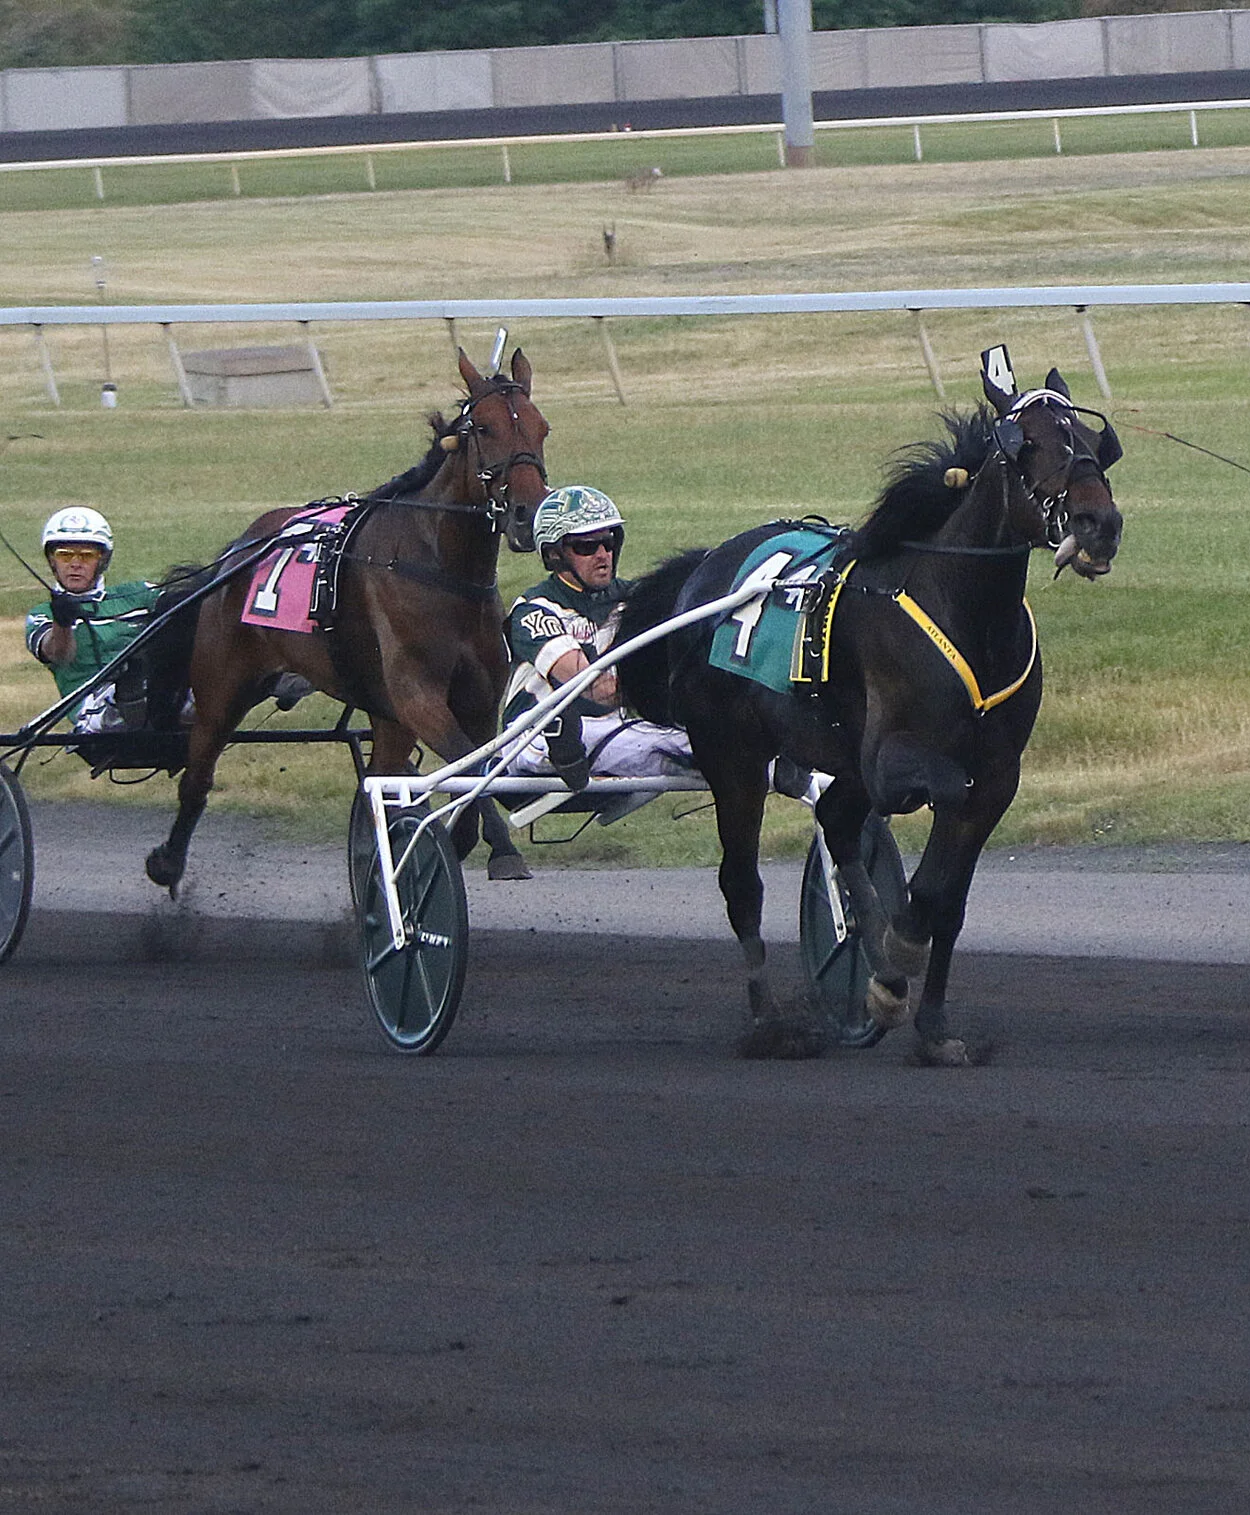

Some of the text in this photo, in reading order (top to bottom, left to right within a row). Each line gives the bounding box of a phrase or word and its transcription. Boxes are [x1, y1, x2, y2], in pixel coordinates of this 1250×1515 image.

[987, 346, 1015, 395] 4
[732, 551, 793, 658] 4
[925, 625, 957, 661] ATLANTA
